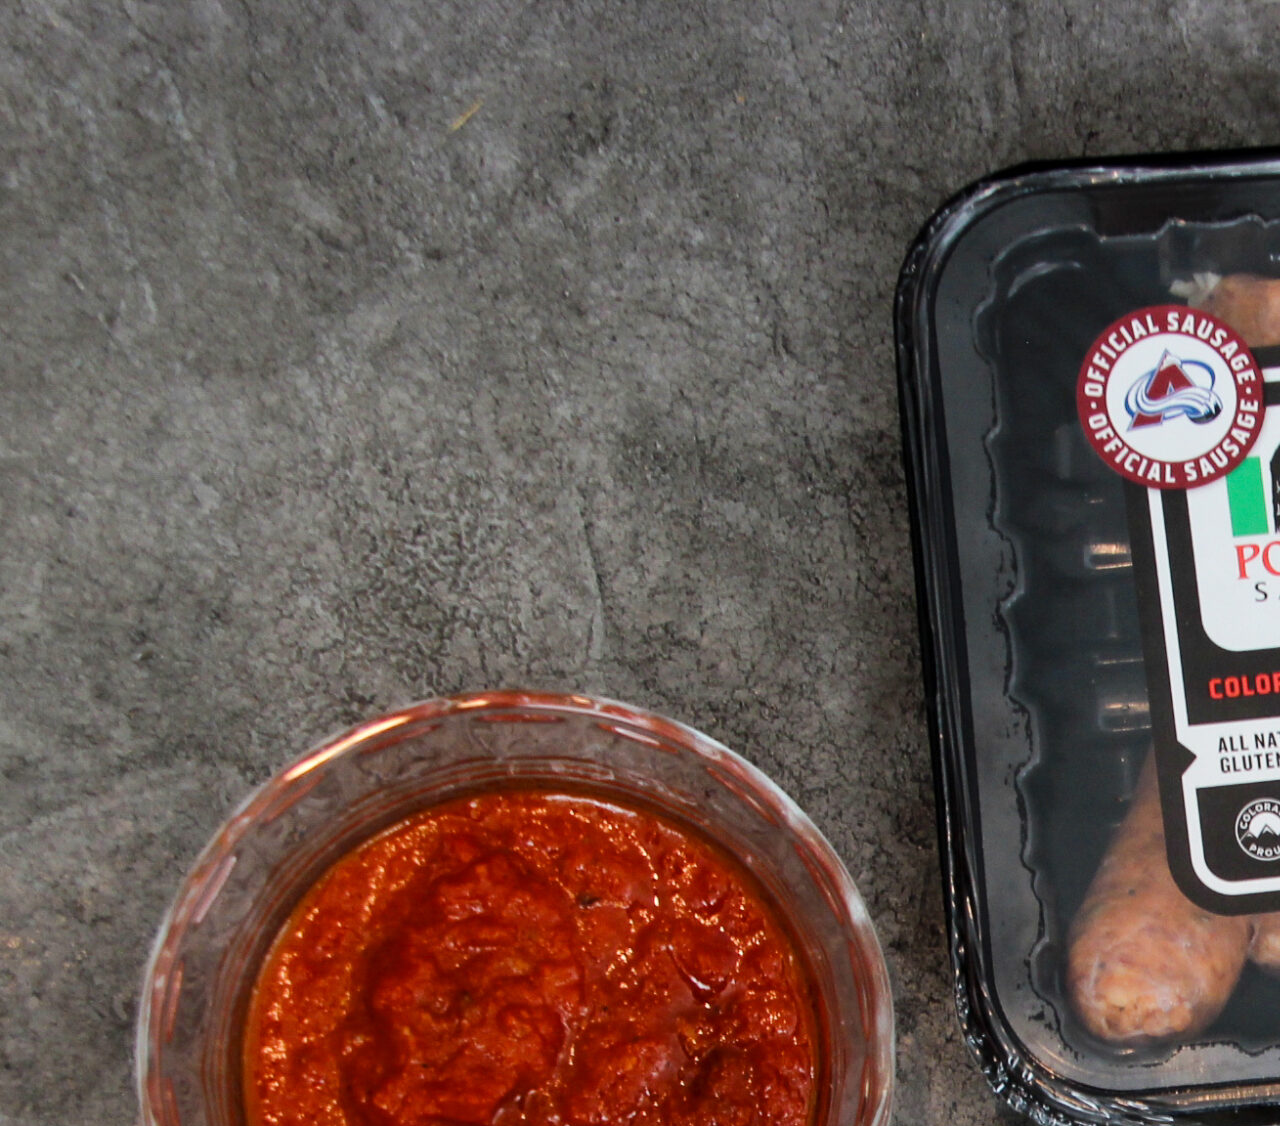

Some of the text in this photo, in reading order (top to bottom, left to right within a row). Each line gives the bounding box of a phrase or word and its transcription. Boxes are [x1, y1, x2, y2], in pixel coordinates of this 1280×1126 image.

[1084, 311, 1256, 398] OFFICIAL SAUSAGE
[1088, 399, 1259, 484] OFFICIAL SAUSAGE
[1218, 734, 1250, 753] ALL
